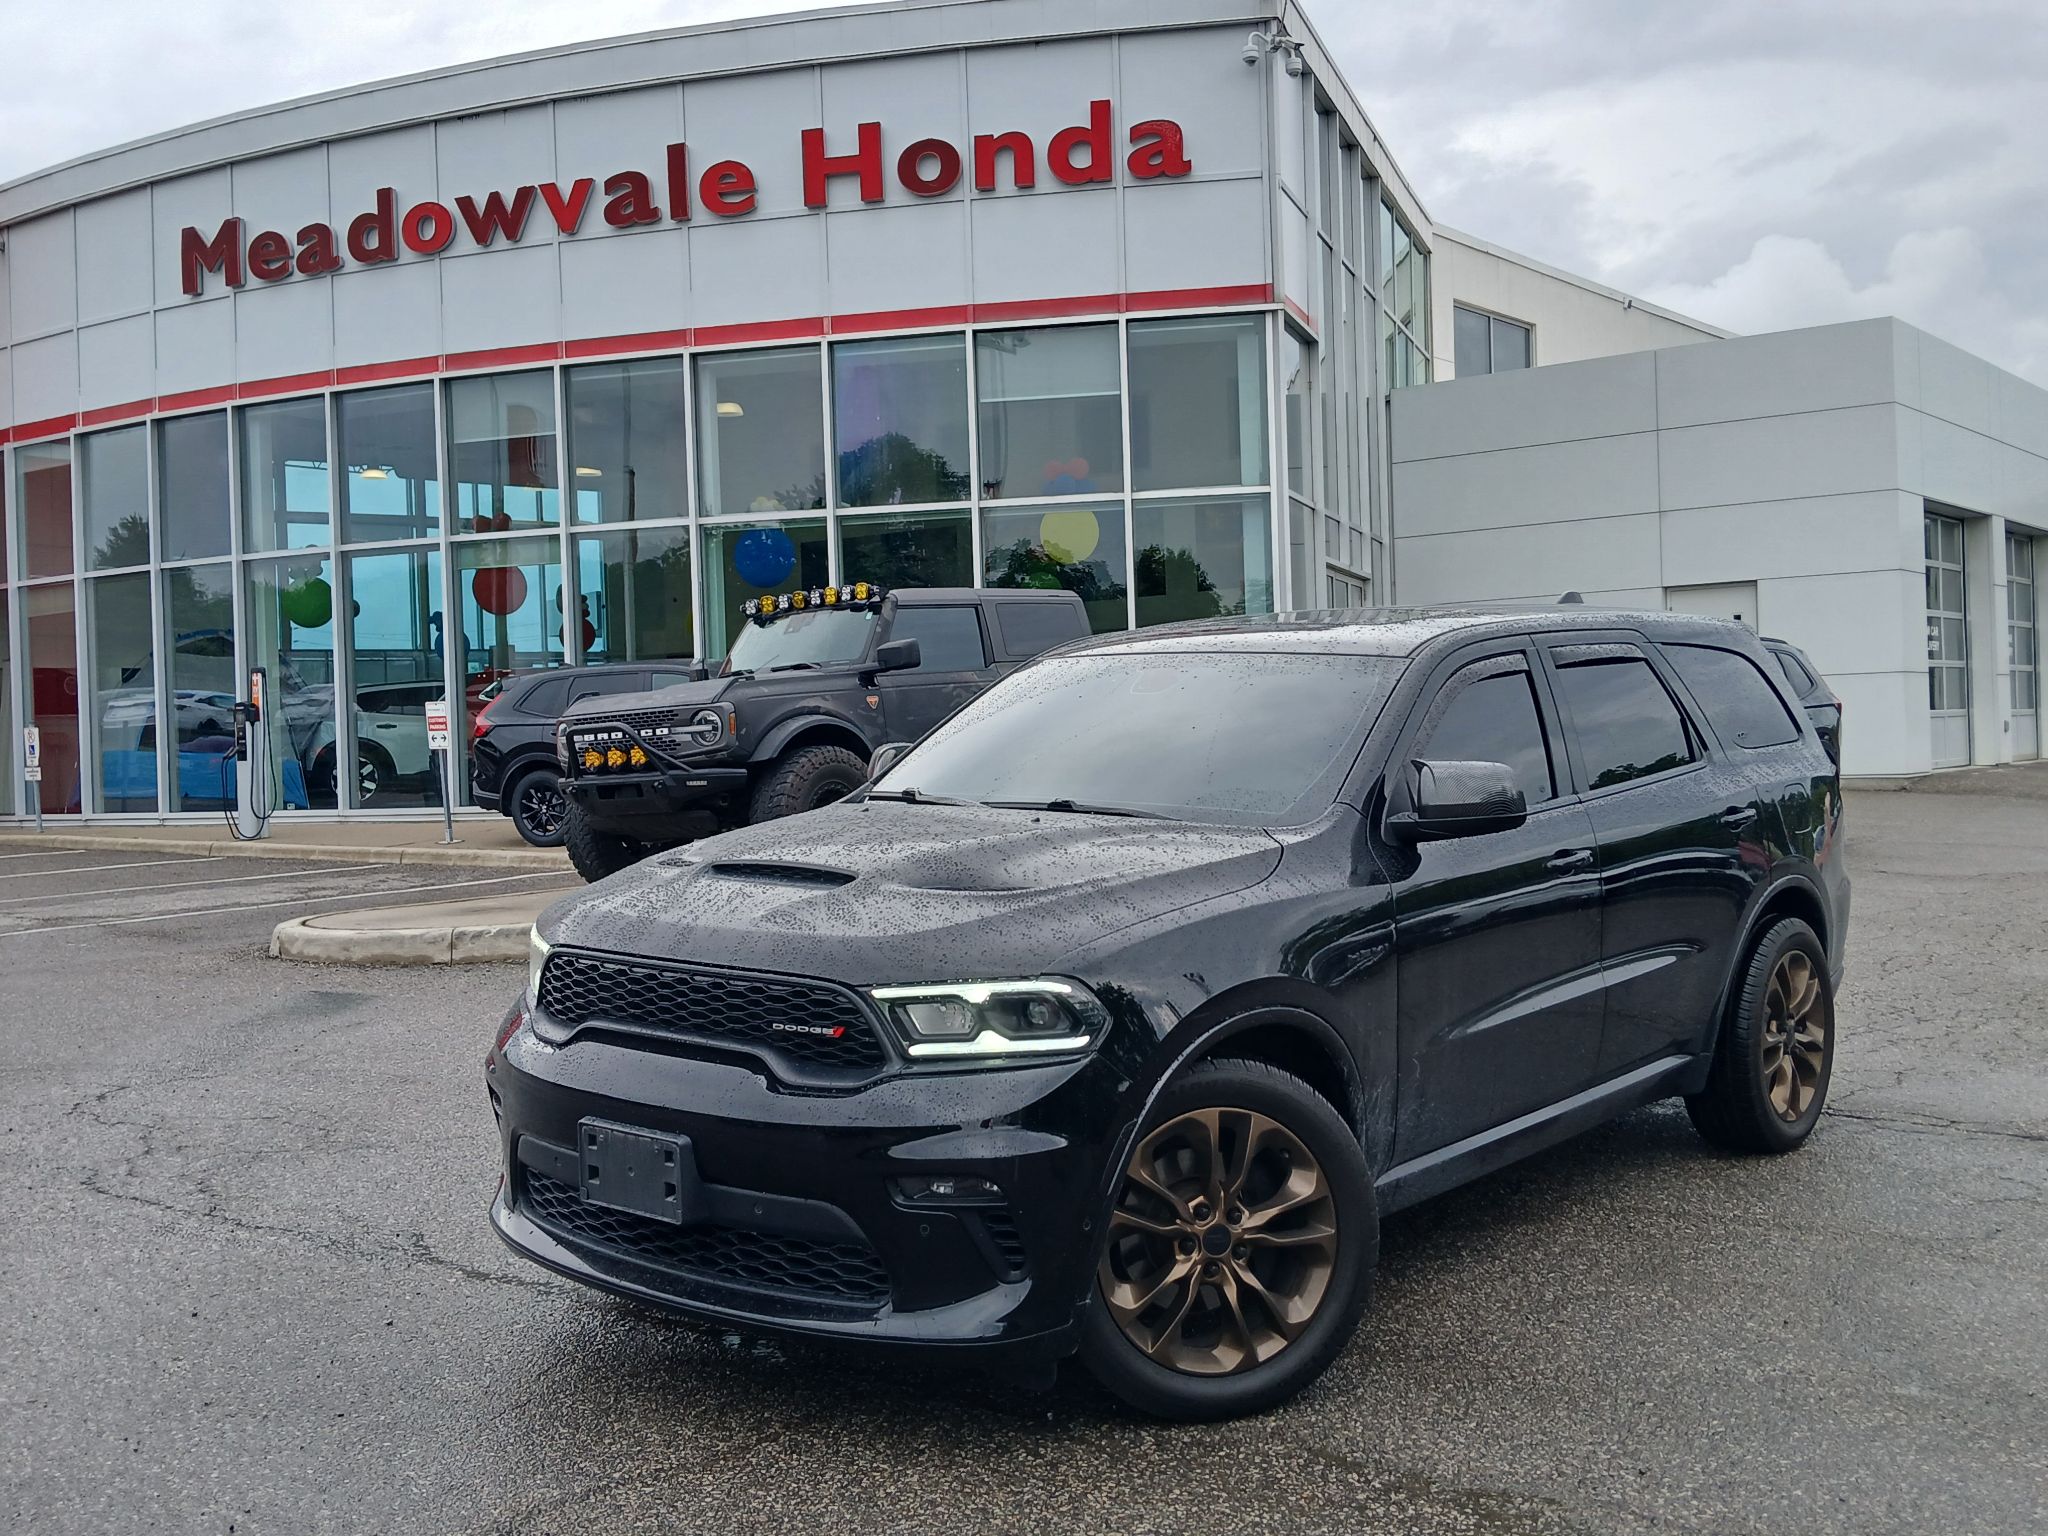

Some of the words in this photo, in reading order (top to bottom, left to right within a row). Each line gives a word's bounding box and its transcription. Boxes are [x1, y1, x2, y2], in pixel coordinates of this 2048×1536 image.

[181, 143, 758, 298] Meadowvale
[801, 99, 1192, 208] Honda
[584, 728, 669, 741] BROCO
[773, 1023, 834, 1035] DODGE
